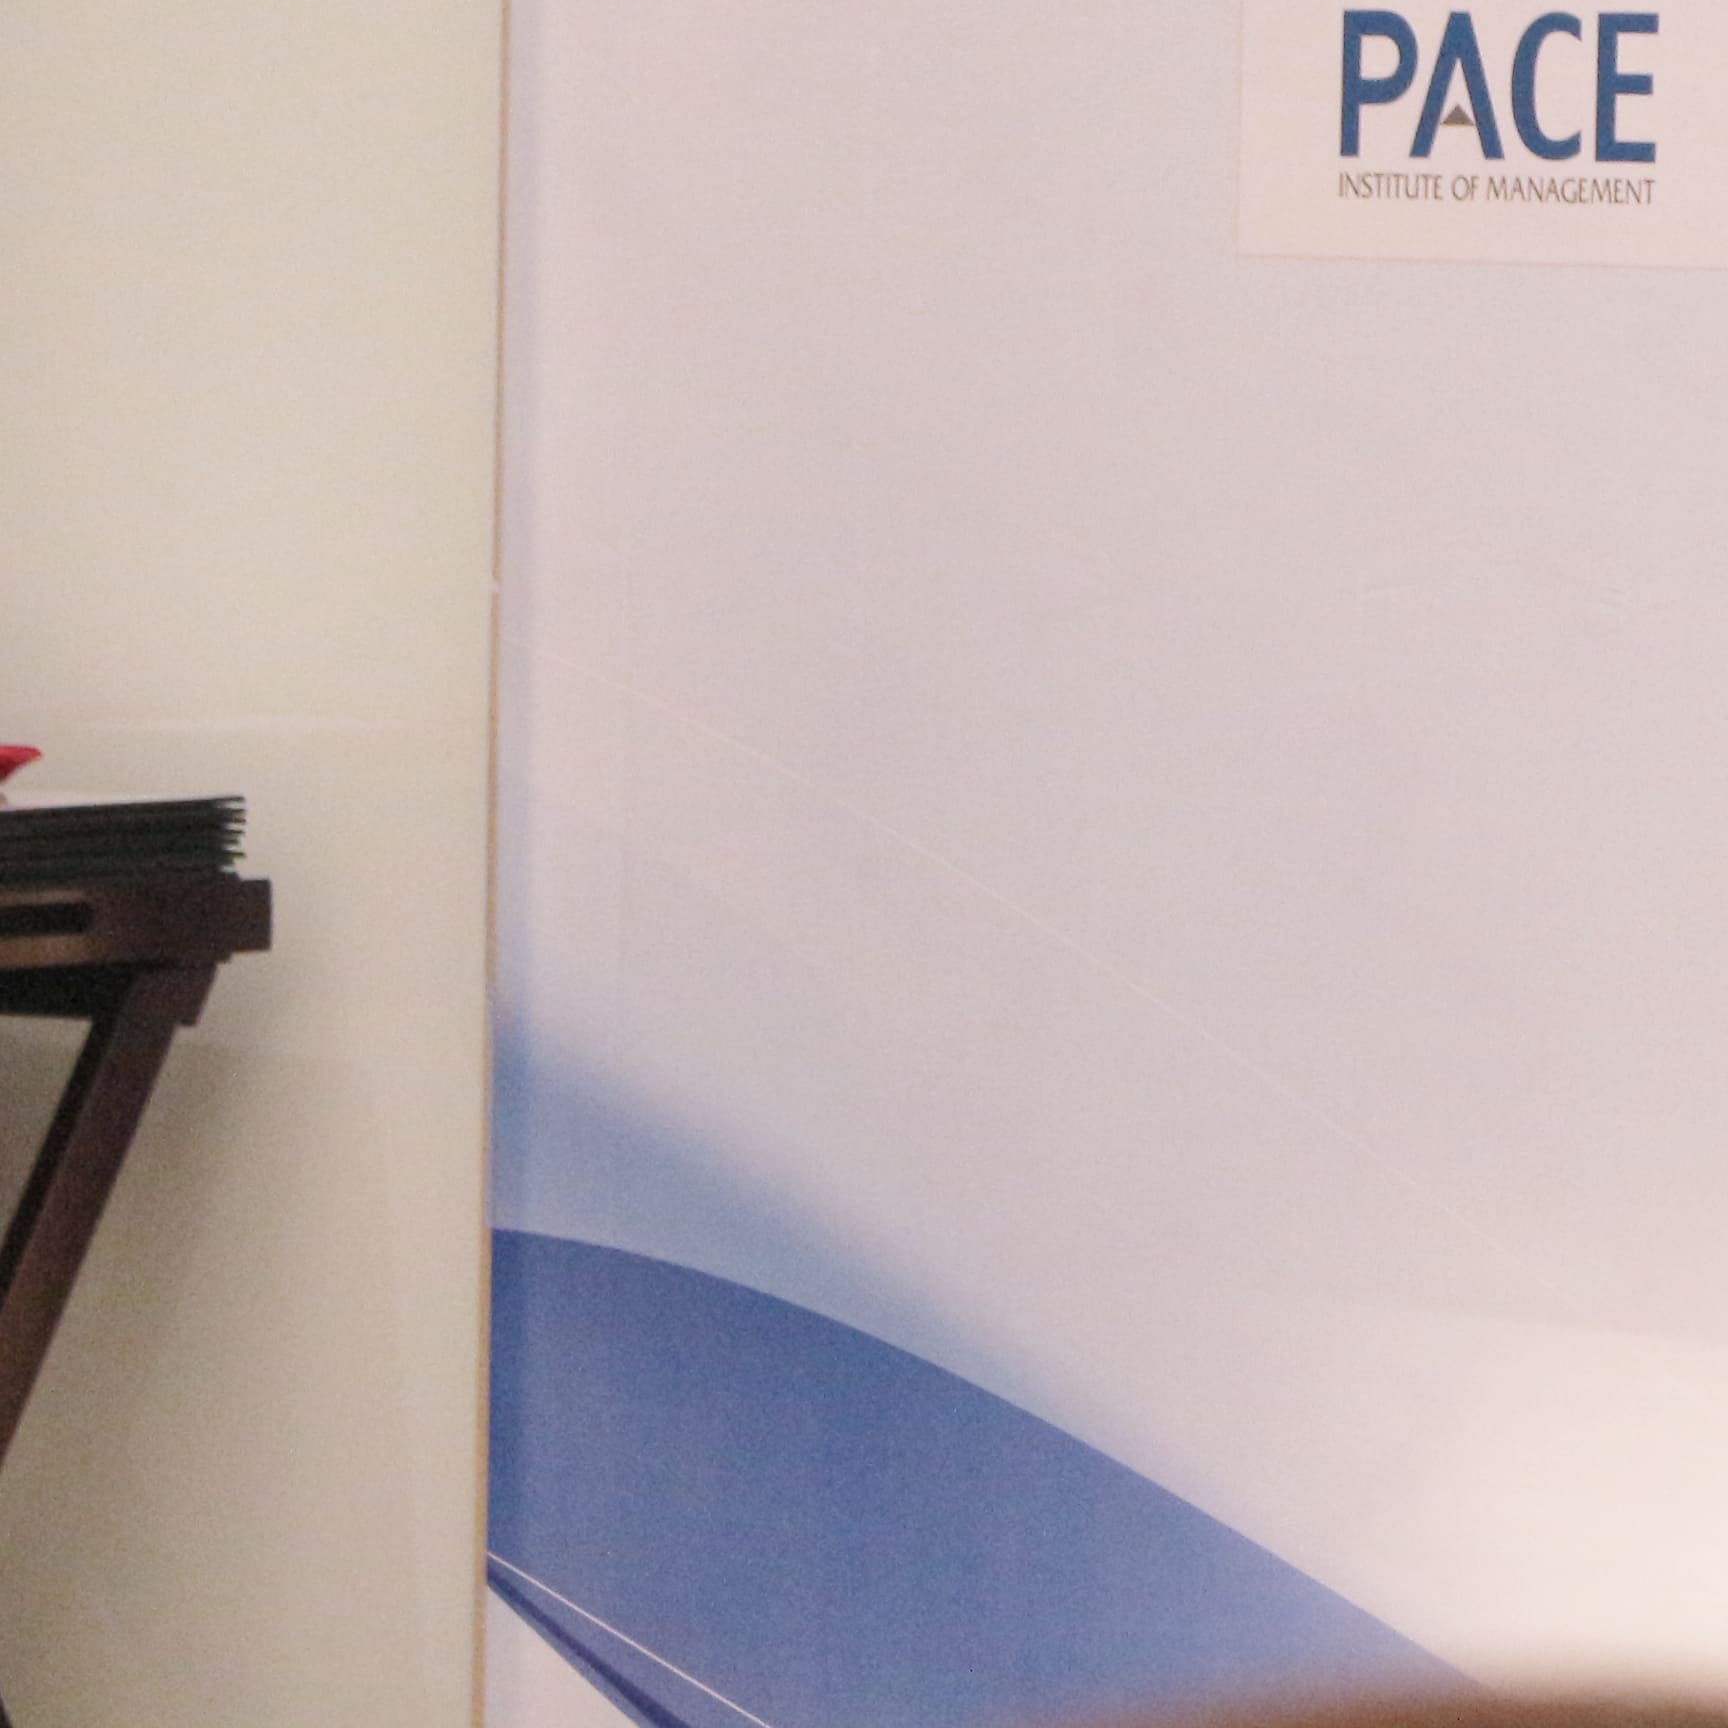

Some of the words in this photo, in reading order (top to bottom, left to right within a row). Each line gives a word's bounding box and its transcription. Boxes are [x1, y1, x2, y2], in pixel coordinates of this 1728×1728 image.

[1339, 8, 1660, 164] PACE
[1337, 172, 1443, 202] INSTITUTE
[1450, 174, 1480, 203] OF
[1485, 175, 1656, 205] MANAGEMENT
